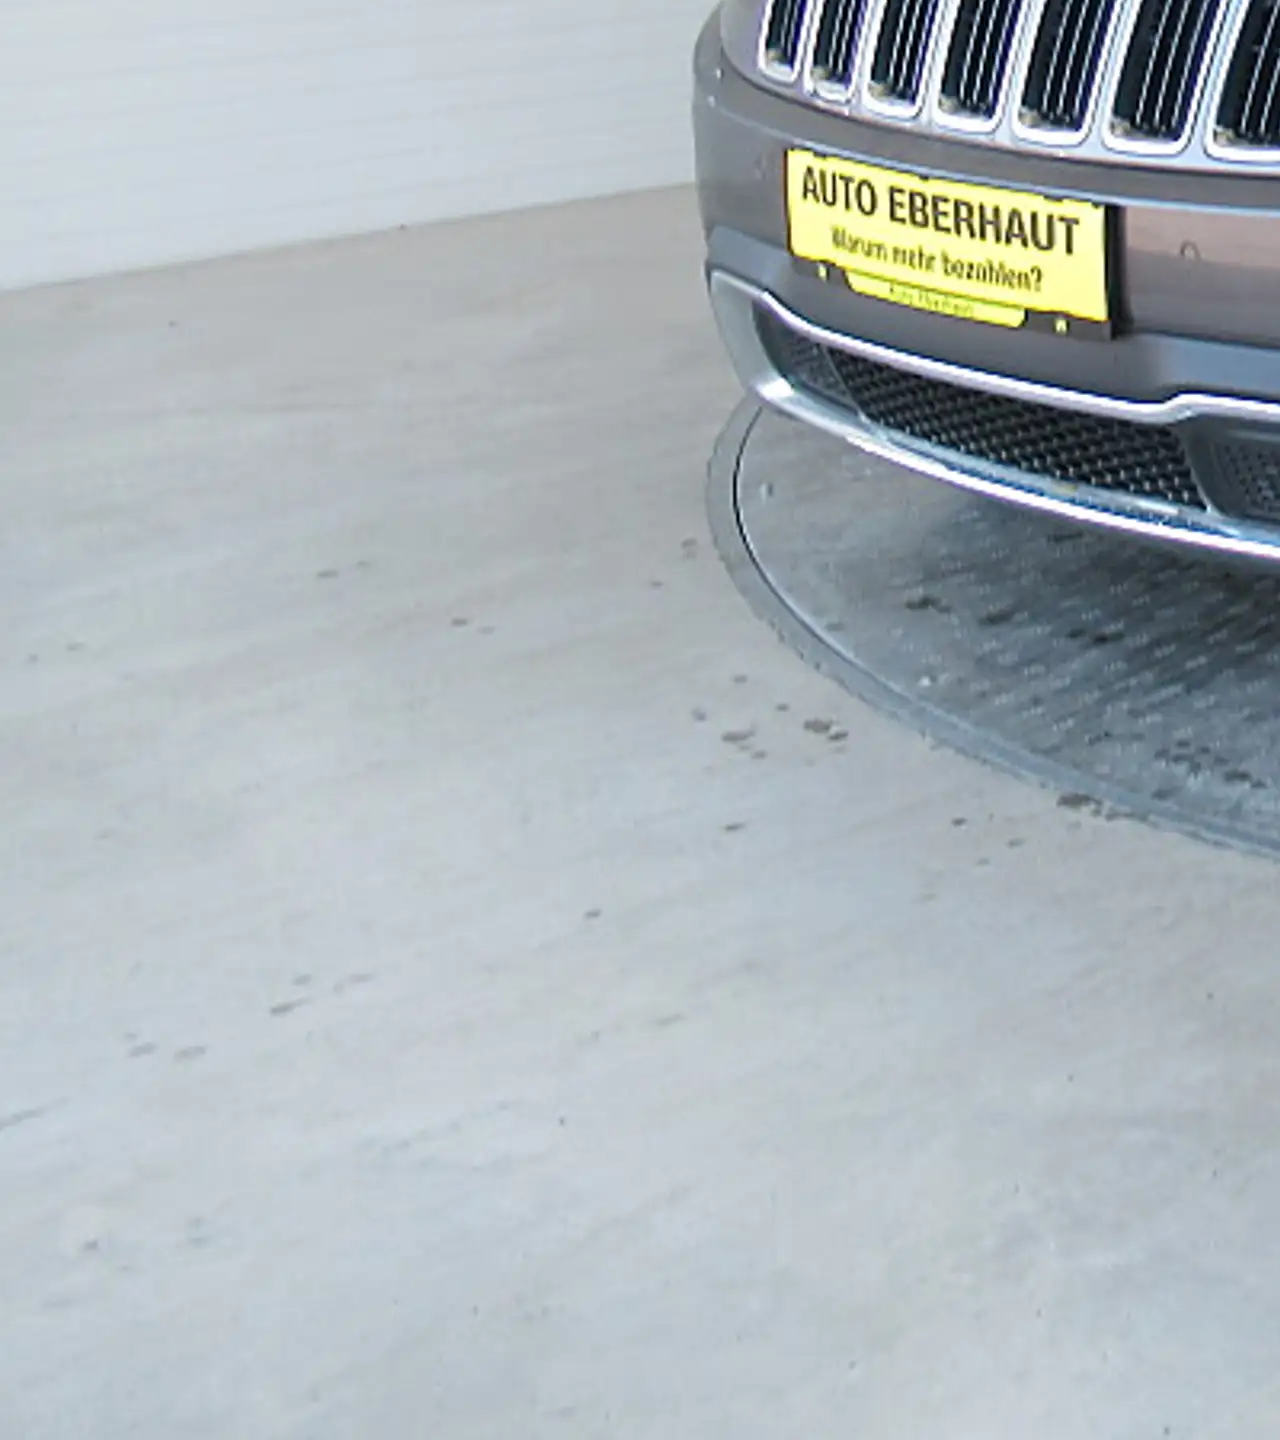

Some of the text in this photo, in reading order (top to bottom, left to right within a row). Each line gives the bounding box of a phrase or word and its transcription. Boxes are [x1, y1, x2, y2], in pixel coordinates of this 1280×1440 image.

[802, 166, 1080, 255] AUTO EBERHAUT
[831, 224, 1043, 293] Warum mehr bezahlen?
